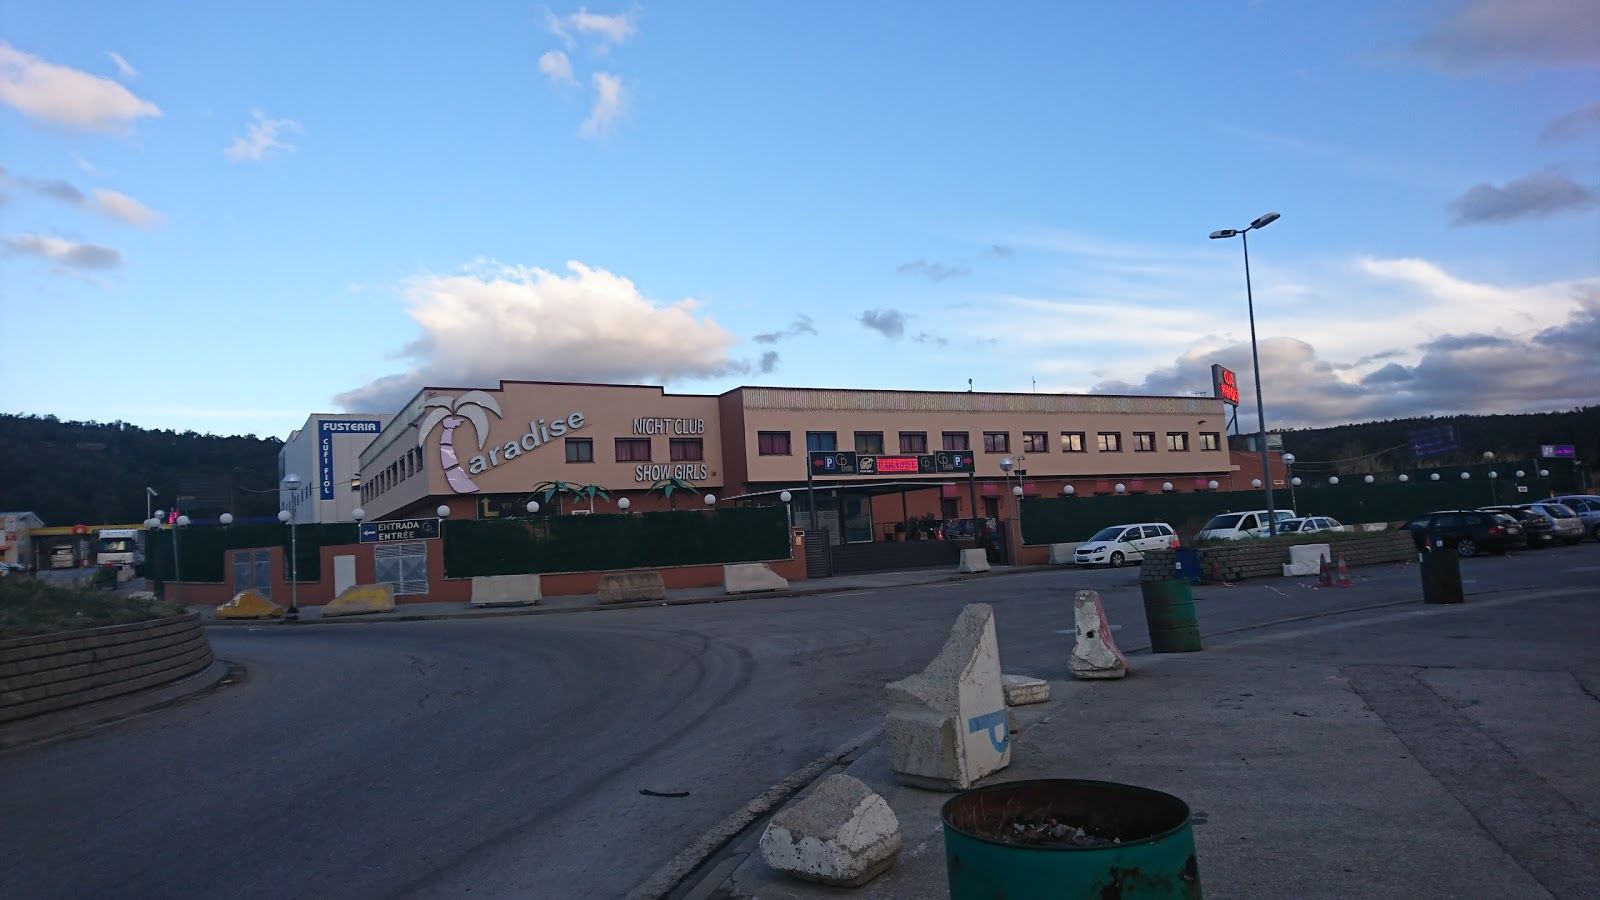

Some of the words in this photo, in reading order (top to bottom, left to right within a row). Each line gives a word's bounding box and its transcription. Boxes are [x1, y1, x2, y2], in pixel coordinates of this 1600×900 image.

[323, 422, 376, 431] FUSTERIA
[633, 418, 671, 435] NIGHT
[674, 418, 705, 435] CLUB
[635, 465, 670, 482] SHOW
[674, 464, 707, 481] GIRLS
[378, 522, 419, 531] ENTRADA
[378, 530, 415, 540] ENTRÉE
